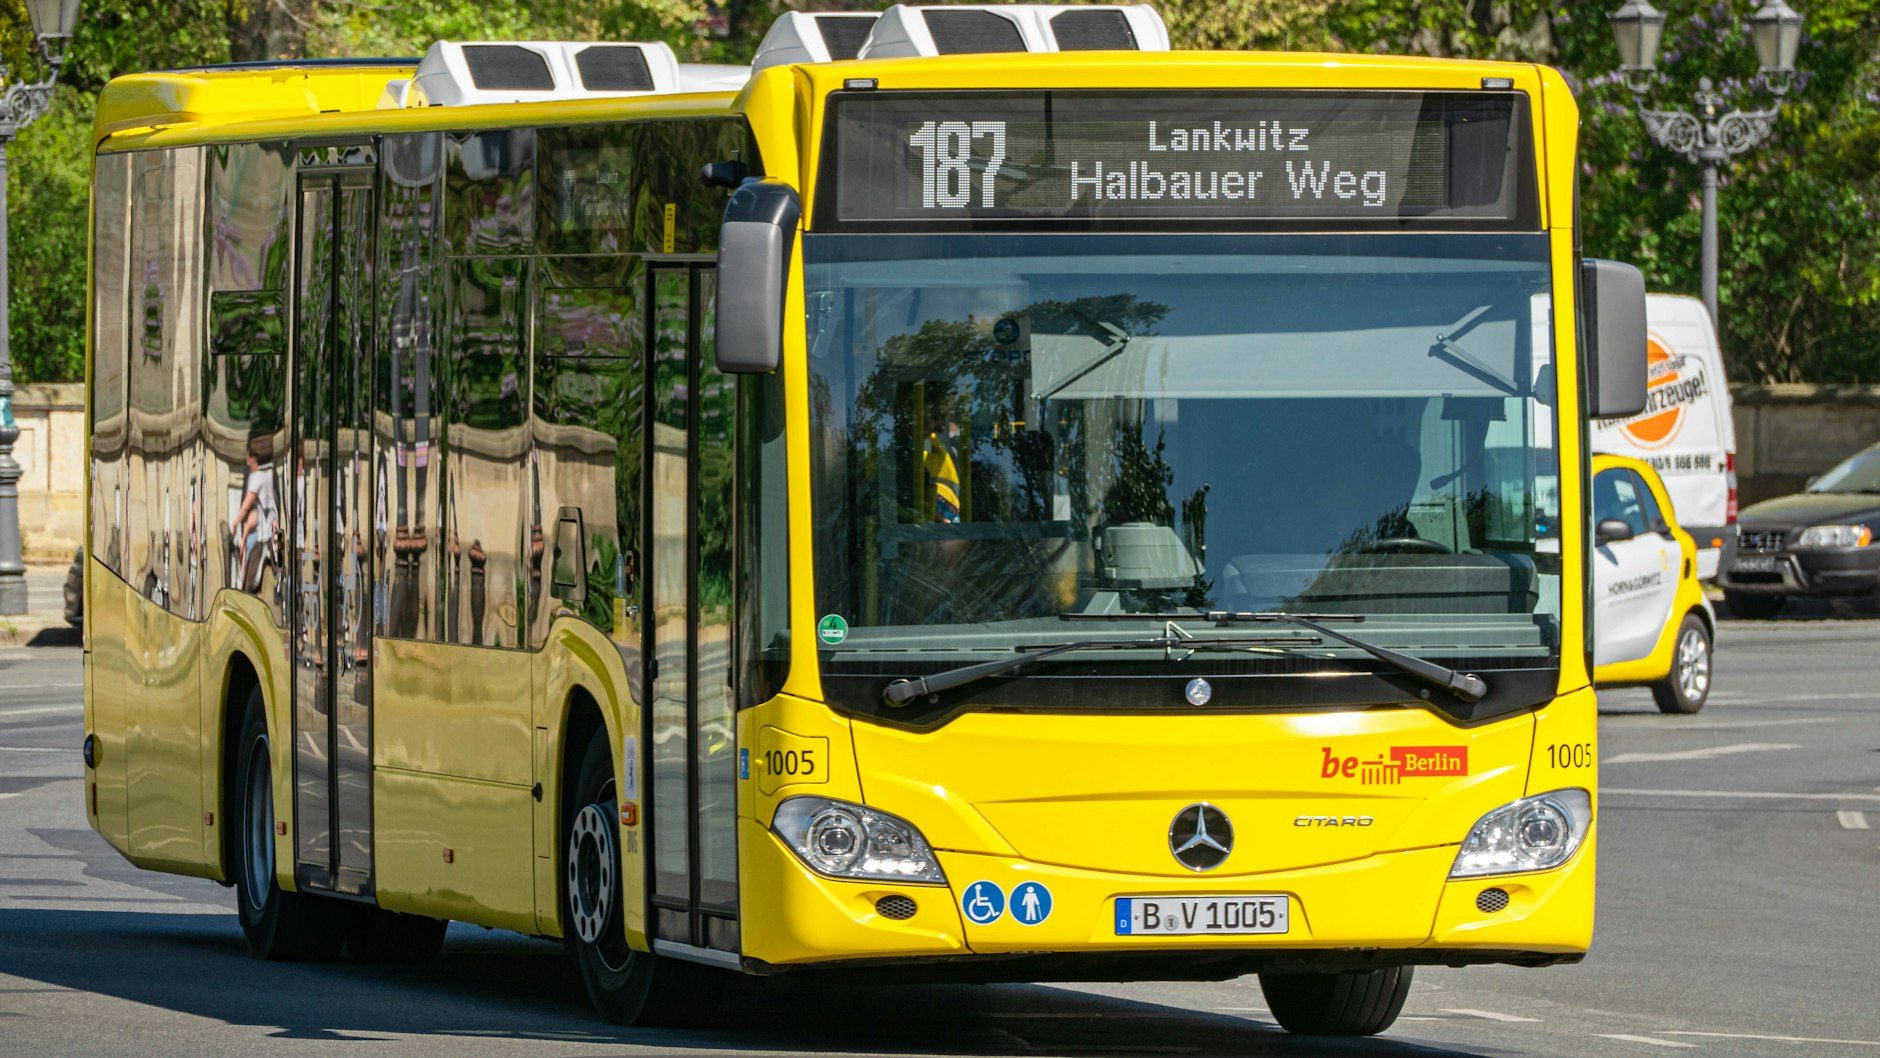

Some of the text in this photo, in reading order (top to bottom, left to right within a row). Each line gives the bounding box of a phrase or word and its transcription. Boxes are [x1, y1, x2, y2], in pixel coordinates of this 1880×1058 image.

[1149, 120, 1309, 151] Lankwitz
[910, 121, 1006, 208] 187
[1071, 161, 1386, 206] Halbauer Weg
[829, 616, 837, 629] 4
[765, 750, 814, 775] 1005
[1321, 747, 1461, 778] be Berlin
[1547, 743, 1591, 768] 1005
[1294, 815, 1374, 827] CITARO
[1120, 919, 1128, 928] D
[1143, 900, 1275, 930] B V 1005
